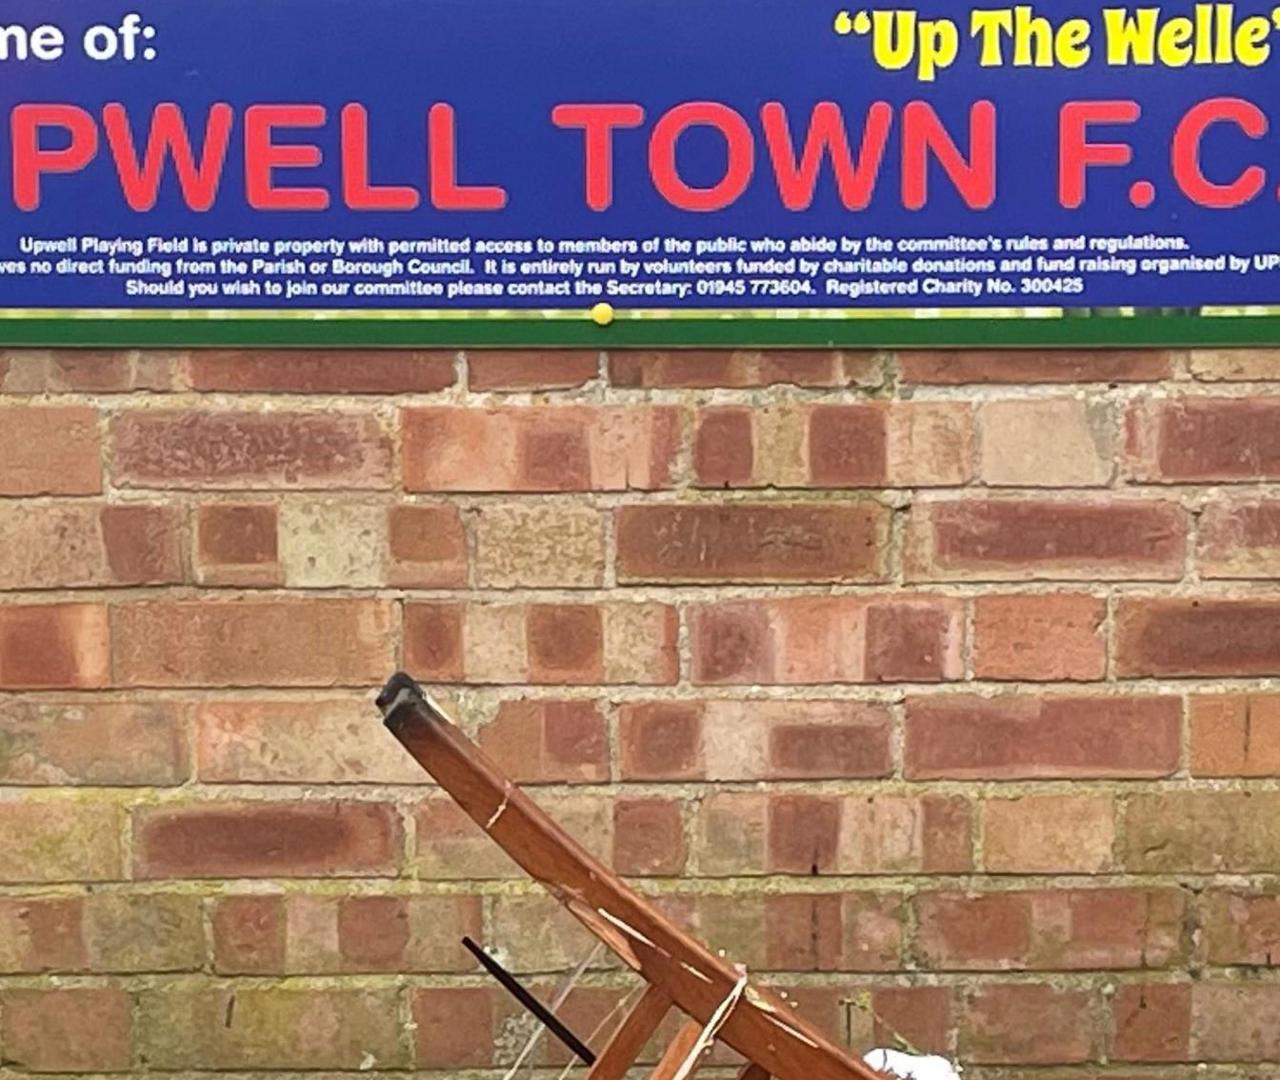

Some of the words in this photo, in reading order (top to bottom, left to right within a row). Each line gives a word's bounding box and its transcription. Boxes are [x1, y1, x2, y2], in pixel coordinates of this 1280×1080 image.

[84, 14, 156, 60] of:
[835, 10, 958, 81] “Up
[971, 6, 1090, 68] The
[552, 100, 995, 211] TOWN
[20, 237, 77, 255] Upwell
[82, 237, 143, 255] Playing
[148, 238, 188, 253] Field
[193, 237, 207, 252] is
[212, 238, 269, 255] private
[274, 239, 345, 255] property
[349, 238, 384, 253] with
[389, 238, 470, 255] permitted
[475, 241, 532, 253] access
[537, 239, 554, 253] to
[559, 238, 637, 253] members
[642, 238, 659, 252] of
[664, 238, 691, 253] the
[696, 237, 747, 255] public
[751, 238, 785, 252] who
[790, 237, 837, 252] abide
[842, 237, 861, 253] by
[866, 237, 893, 251] the
[897, 236, 1002, 252] committee's
[1006, 236, 1048, 250] rules
[1053, 235, 1085, 250] and
[1090, 234, 1189, 253] regulations.
[31, 262, 51, 273] no
[56, 259, 104, 273] direct
[109, 258, 171, 277] funding
[176, 259, 215, 273] from
[220, 259, 247, 274] the
[253, 259, 305, 274] Parish
[310, 263, 328, 274] or
[332, 259, 403, 276] Borough
[408, 259, 474, 274] Council.
[485, 259, 497, 274] It
[502, 260, 516, 274] is
[521, 259, 583, 275] entirely
[588, 262, 616, 273] run
[620, 259, 639, 276] by
[644, 259, 731, 274] volunteers
[736, 258, 795, 273] funded
[800, 258, 819, 275] by
[824, 258, 907, 273] charitable
[912, 258, 996, 272] donations
[1000, 257, 1032, 272] and
[1037, 257, 1075, 271] fund
[1079, 256, 1136, 274] raising
[1141, 256, 1225, 273] organised
[1230, 255, 1250, 273] by
[126, 280, 184, 294] Should
[188, 283, 218, 298] you
[222, 280, 260, 294] wish
[265, 281, 282, 294] to
[286, 280, 317, 298] join
[322, 284, 350, 294] our
[354, 280, 443, 295] committee
[448, 280, 503, 298] please
[507, 281, 570, 295] contact
[575, 280, 602, 294] the
[607, 280, 692, 297] Secretary:
[697, 280, 745, 294] 01945
[826, 279, 918, 297] Registered
[922, 278, 982, 297] Charity
[987, 278, 1015, 293] No.
[1021, 278, 1083, 293] 300425
